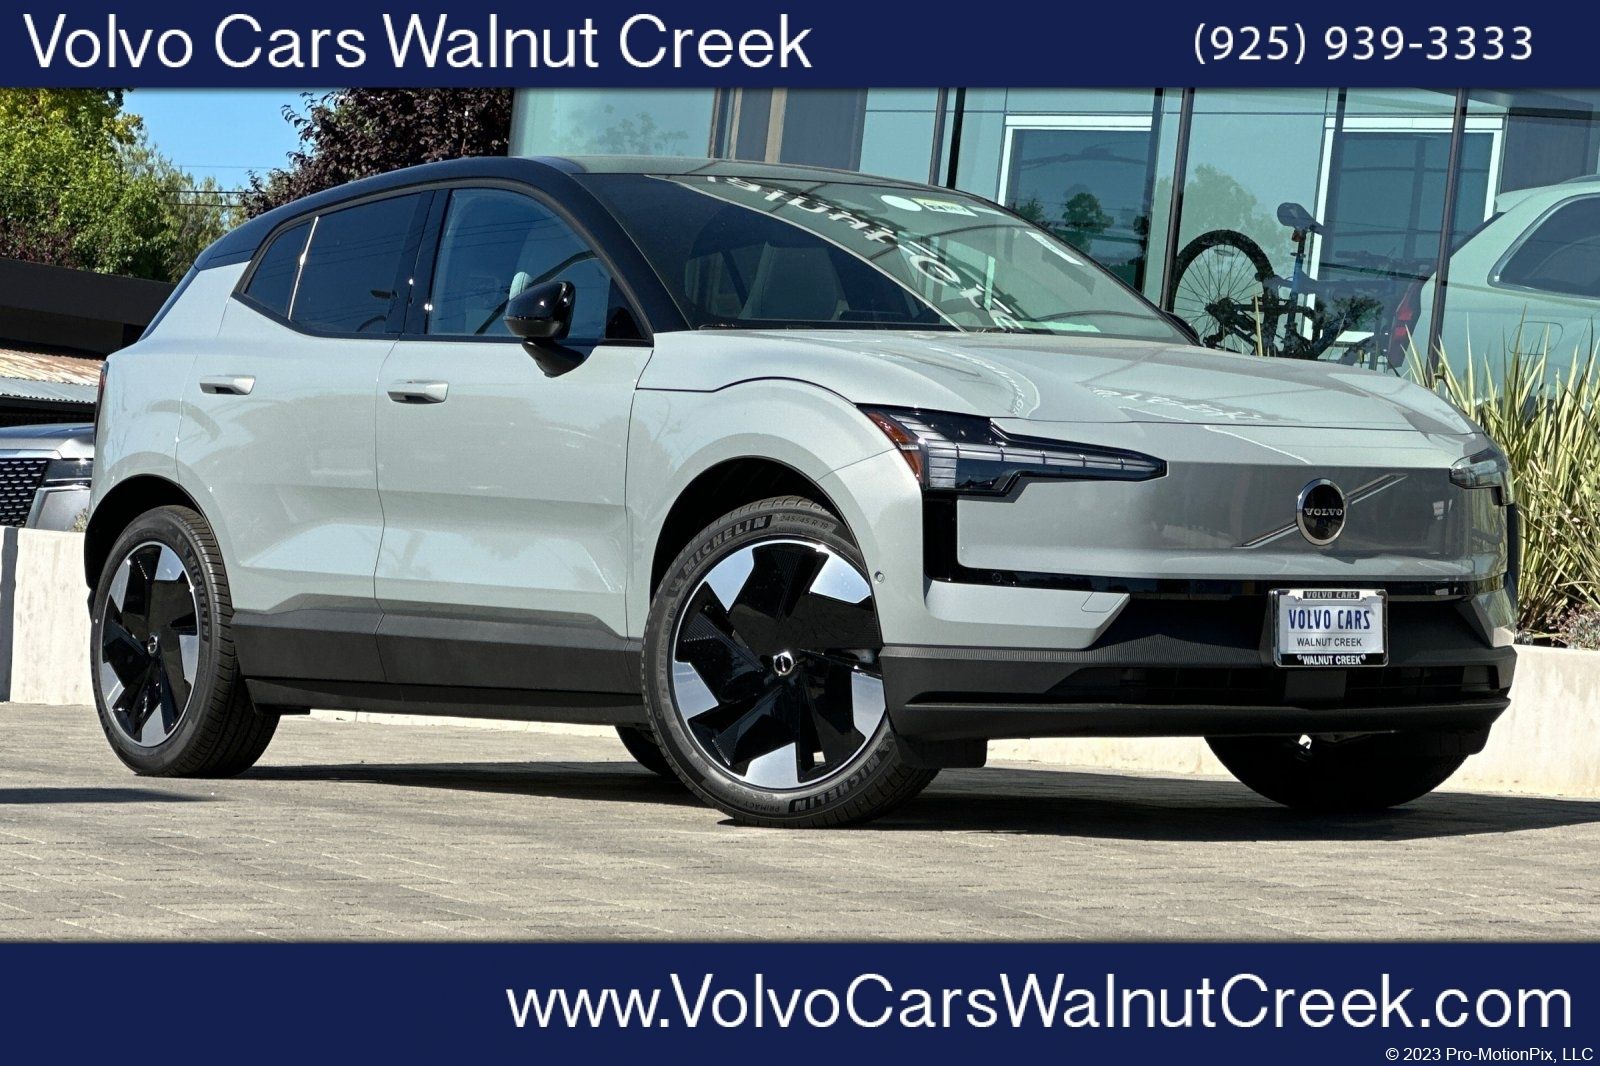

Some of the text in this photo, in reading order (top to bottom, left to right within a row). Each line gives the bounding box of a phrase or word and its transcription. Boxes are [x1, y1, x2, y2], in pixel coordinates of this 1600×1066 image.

[1304, 507, 1343, 516] VOLVO
[683, 516, 767, 573] MICHELIN
[1306, 591, 1357, 599] VOLVO CARS
[1288, 609, 1371, 629] VOLVO CARS
[1296, 638, 1362, 647] WALNUT CREEK
[794, 754, 880, 811] MICHELIN
